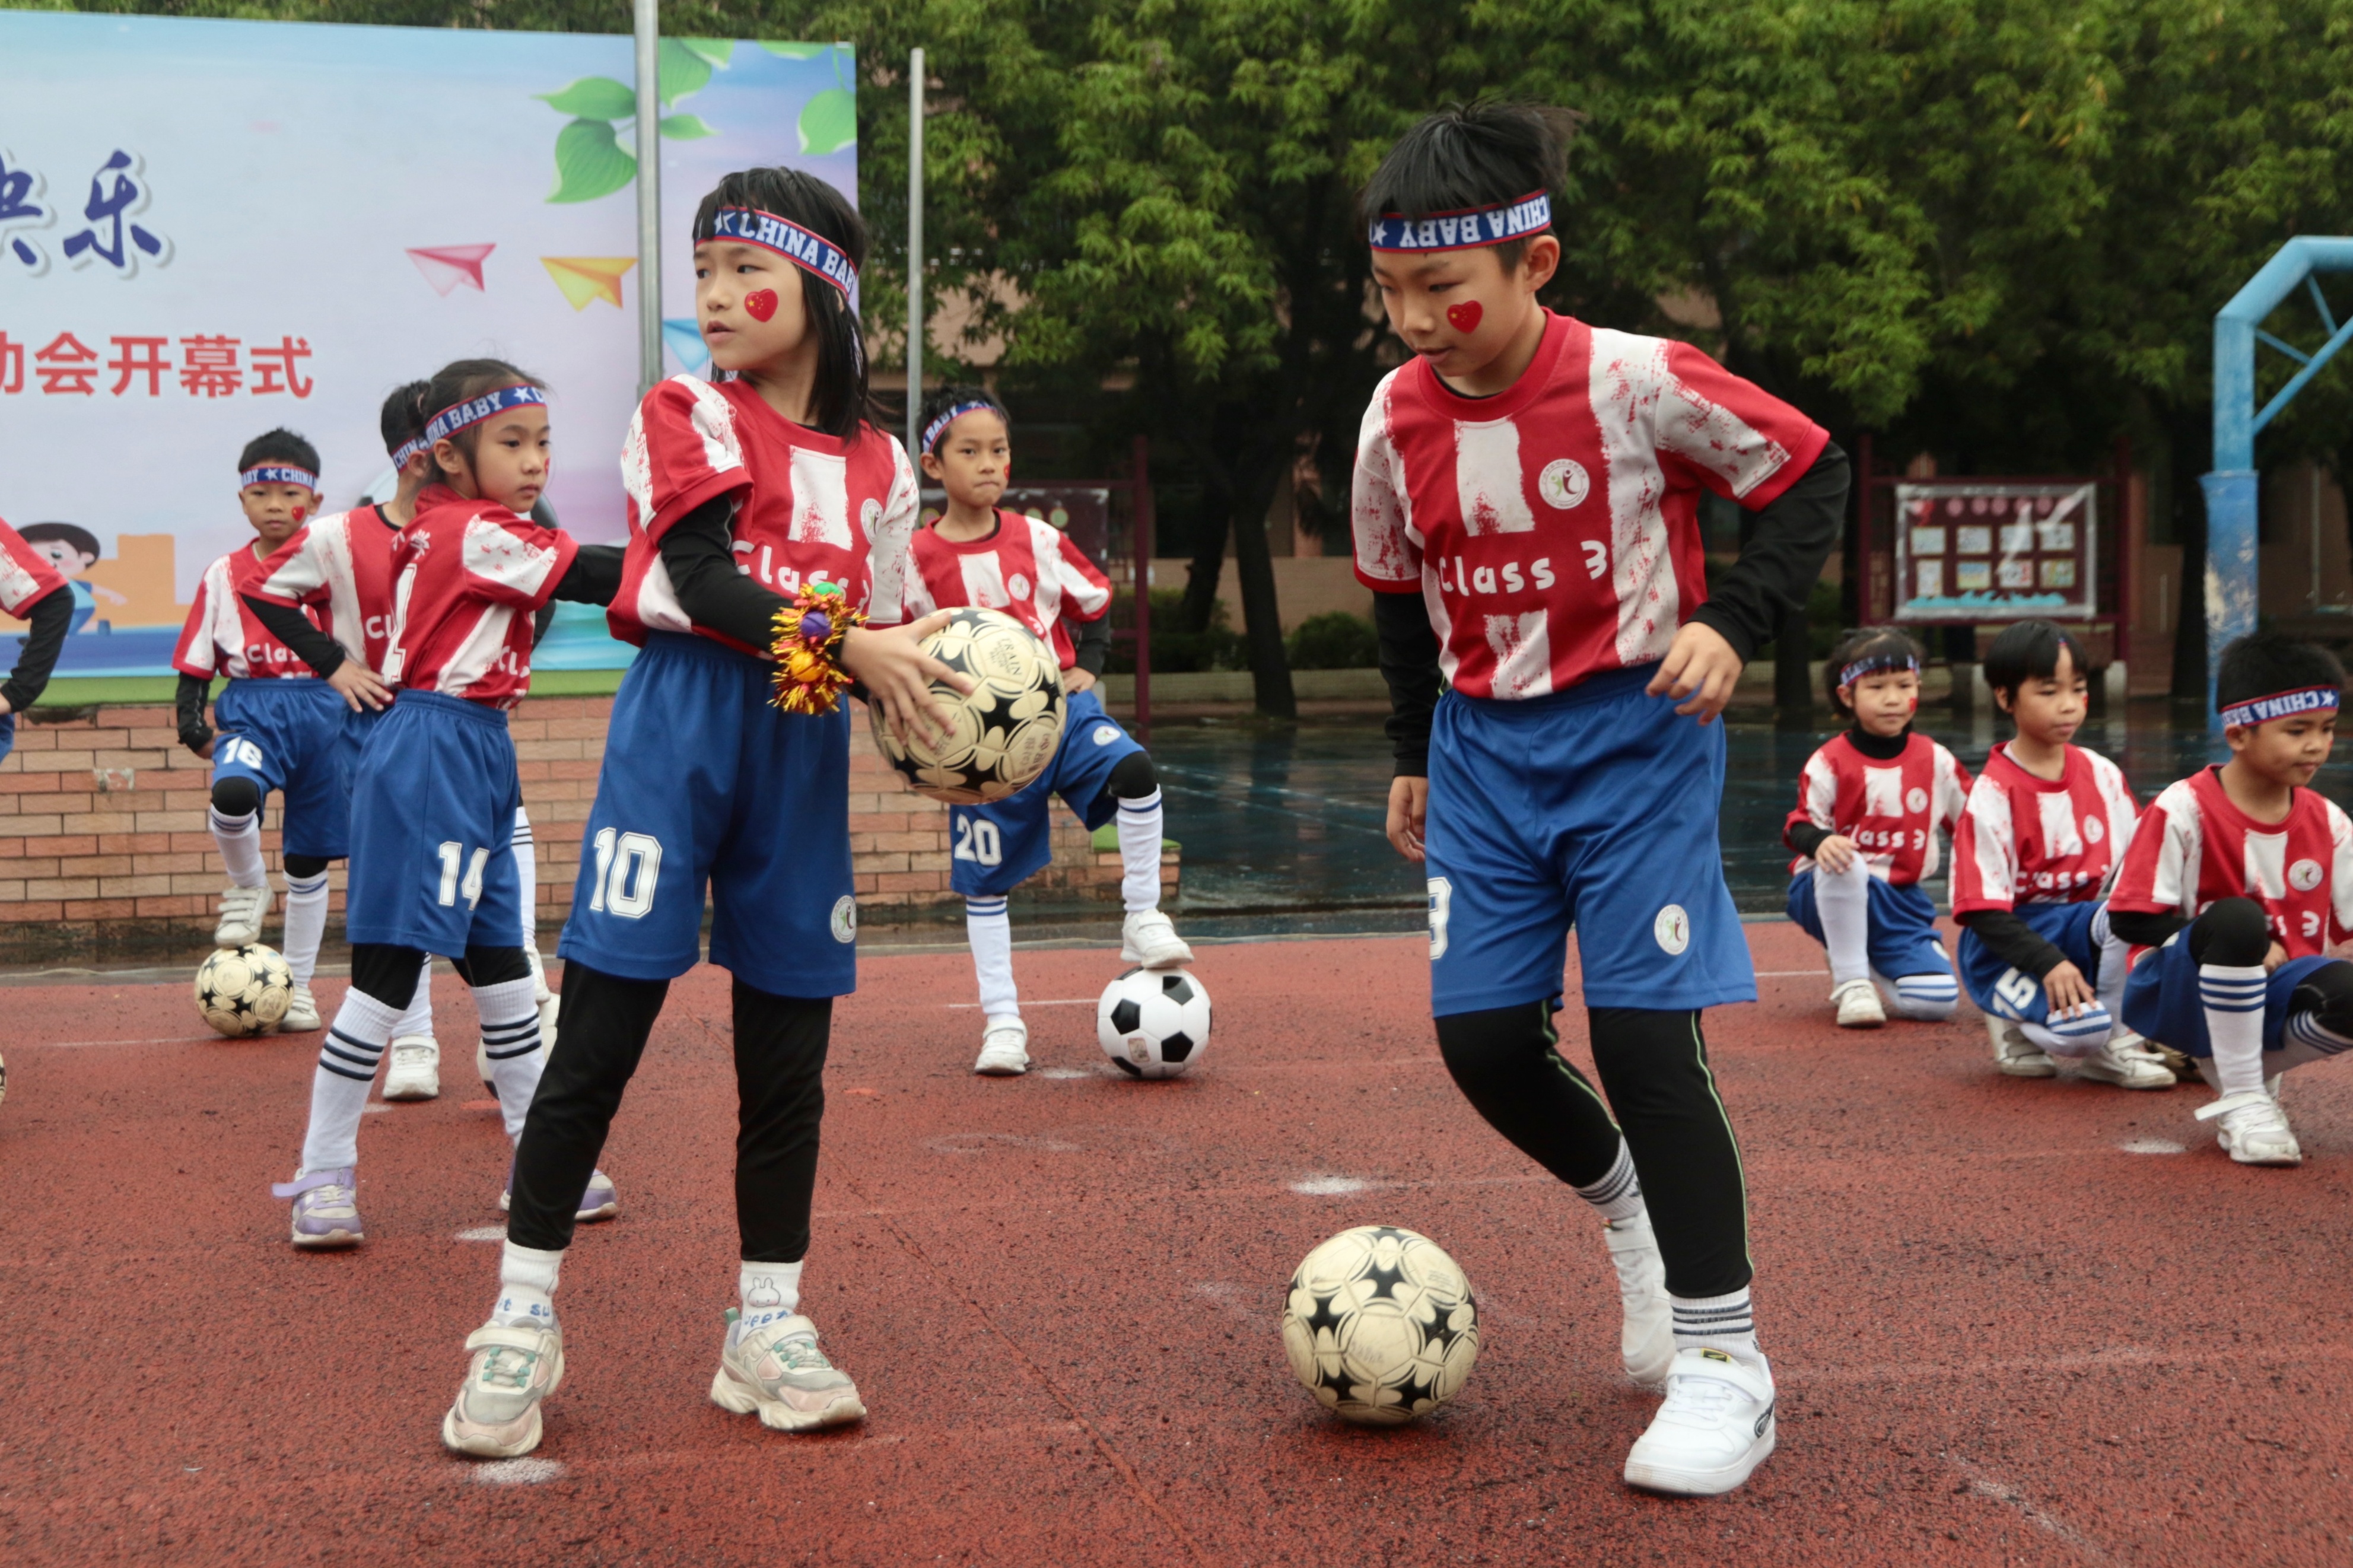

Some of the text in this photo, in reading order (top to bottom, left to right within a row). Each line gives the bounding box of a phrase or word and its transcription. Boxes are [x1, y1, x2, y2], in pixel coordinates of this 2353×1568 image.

[739, 211, 819, 267] CHINA
[1399, 196, 1549, 248] CHINA BABY
[447, 391, 503, 430] BABY
[281, 467, 314, 489] CHINA
[1438, 540, 1607, 597] Class 3
[2255, 690, 2320, 720] CHINA
[954, 813, 1003, 866] 20
[1913, 828, 1926, 851] 3
[438, 841, 490, 911] 14
[590, 826, 663, 919] 10
[2301, 910, 2320, 937] 3
[1992, 966, 2038, 1022] 15
